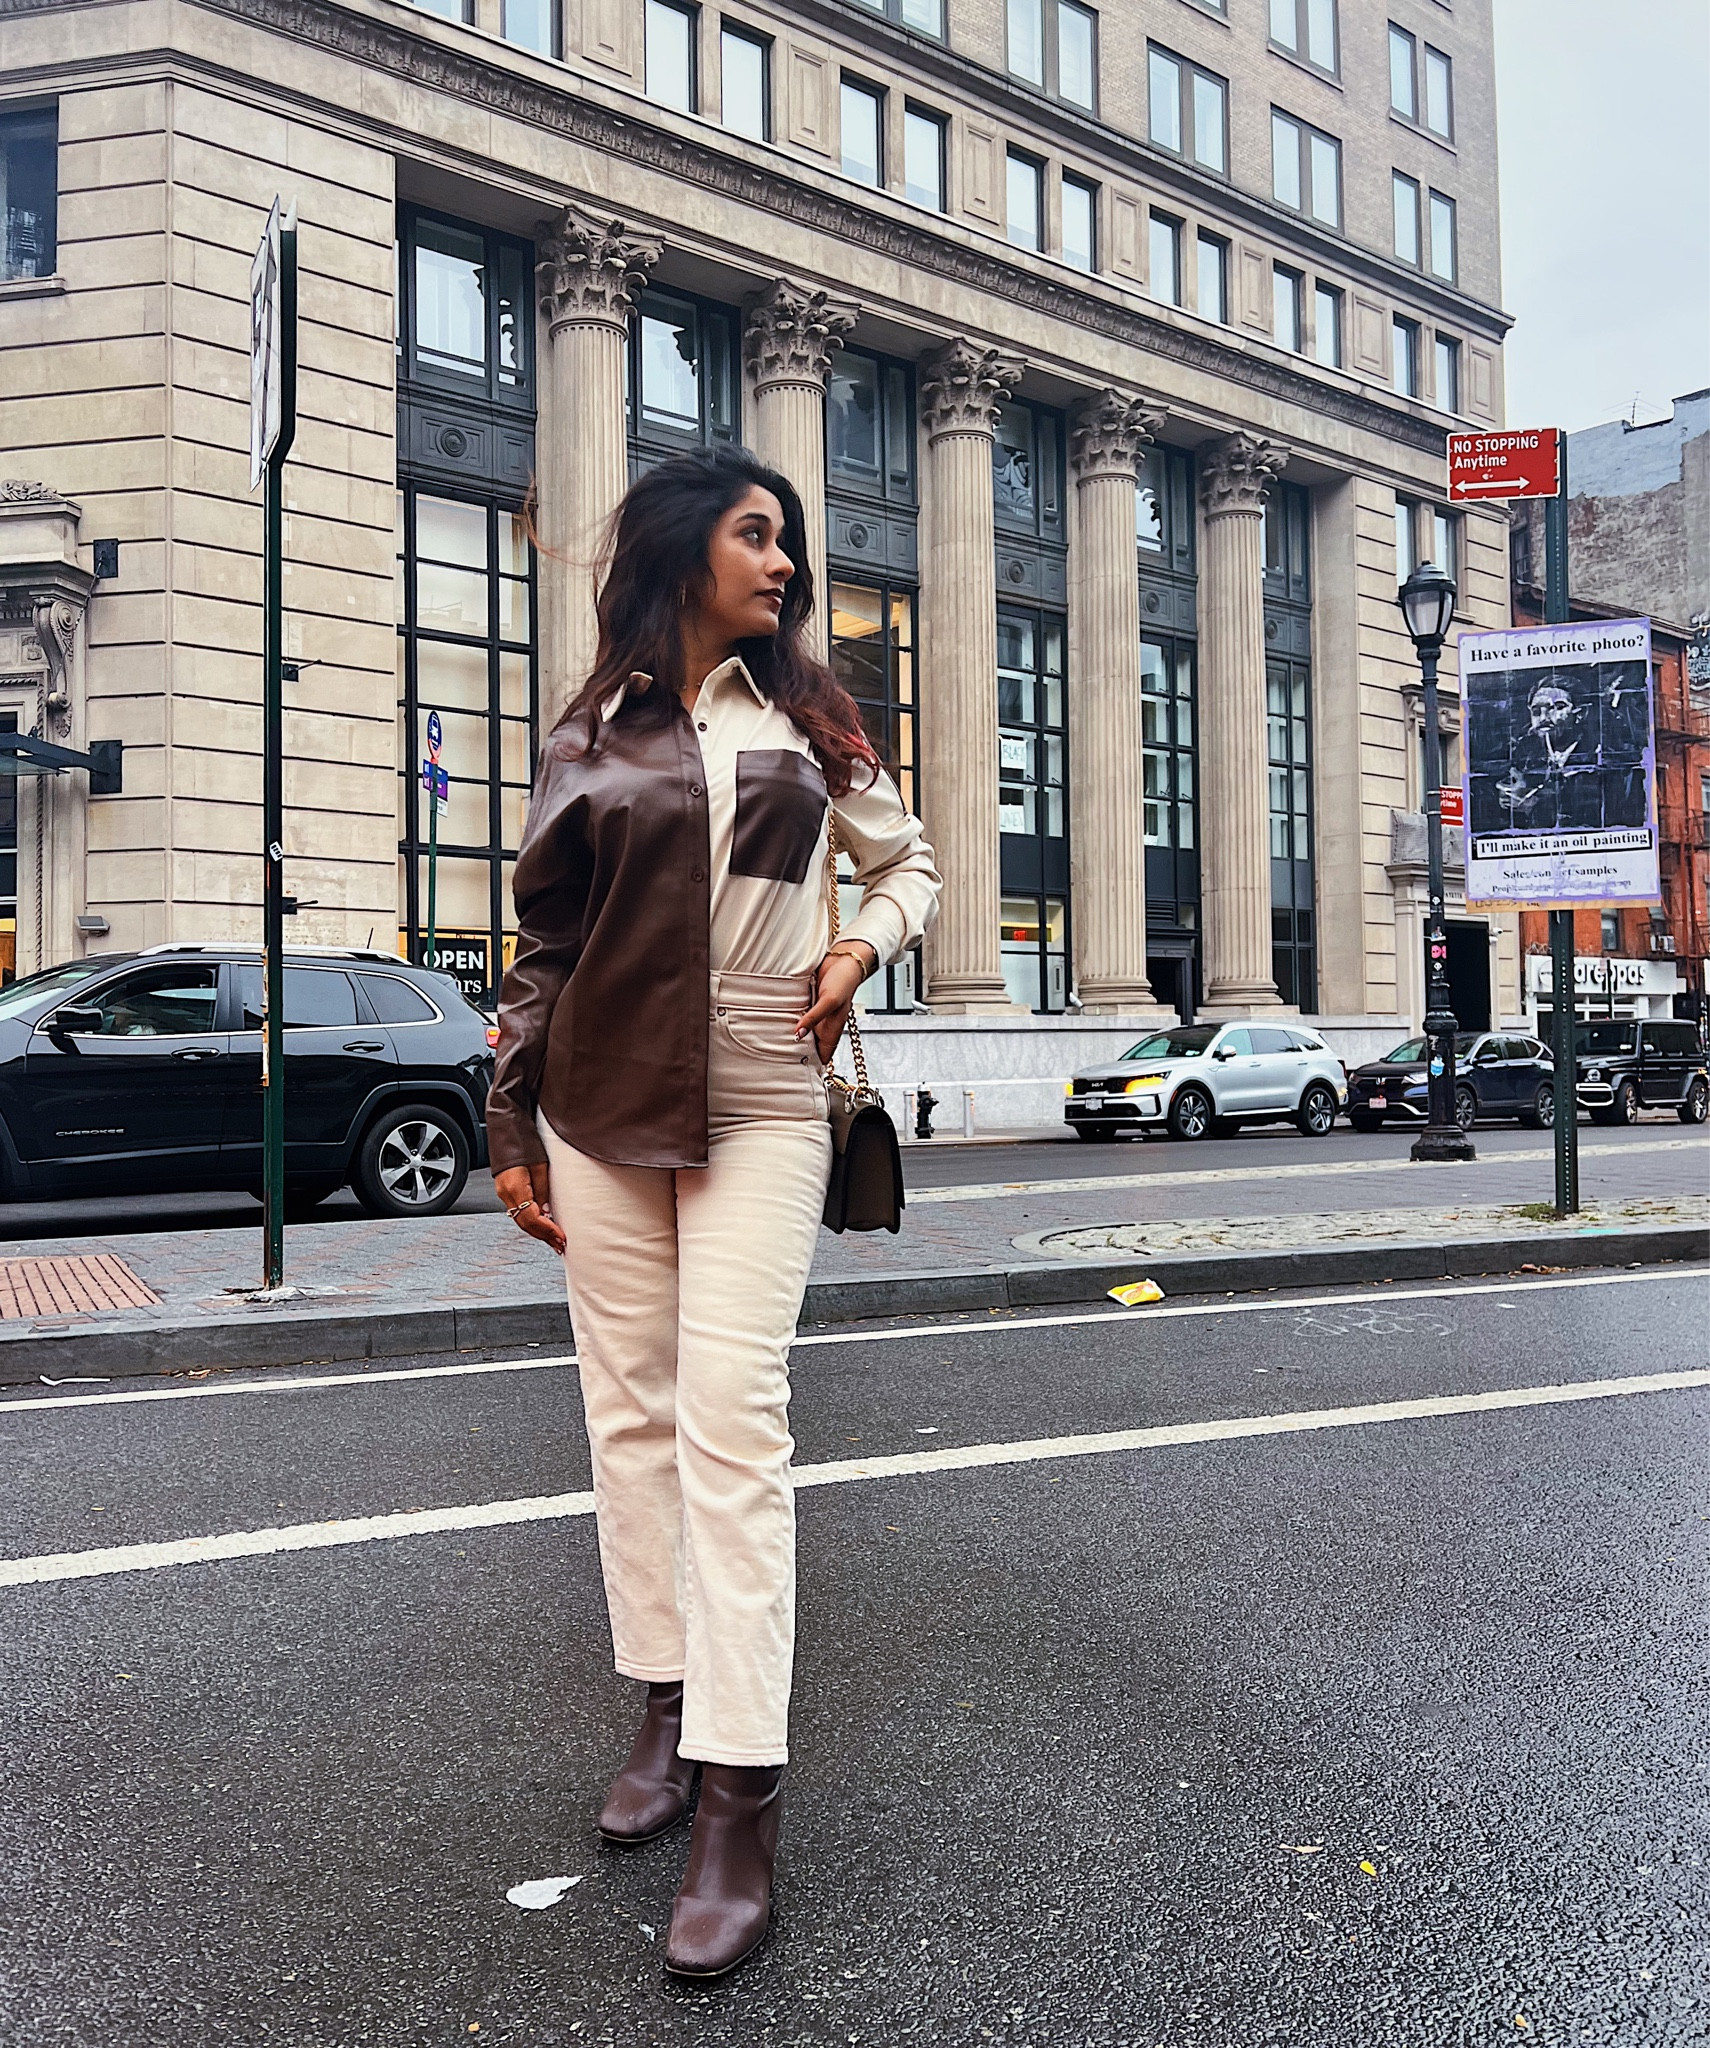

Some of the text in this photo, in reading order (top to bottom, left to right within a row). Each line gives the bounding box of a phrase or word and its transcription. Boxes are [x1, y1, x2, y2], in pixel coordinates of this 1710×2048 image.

[1454, 435, 1539, 454] NO STOPPING
[1454, 454, 1508, 471] Anytime
[1471, 634, 1645, 662] Have a favorite photo?
[1481, 831, 1648, 853] I'll make it an oil painting
[422, 950, 484, 969] OPEN
[55, 1128, 124, 1137] CHEROKEE
